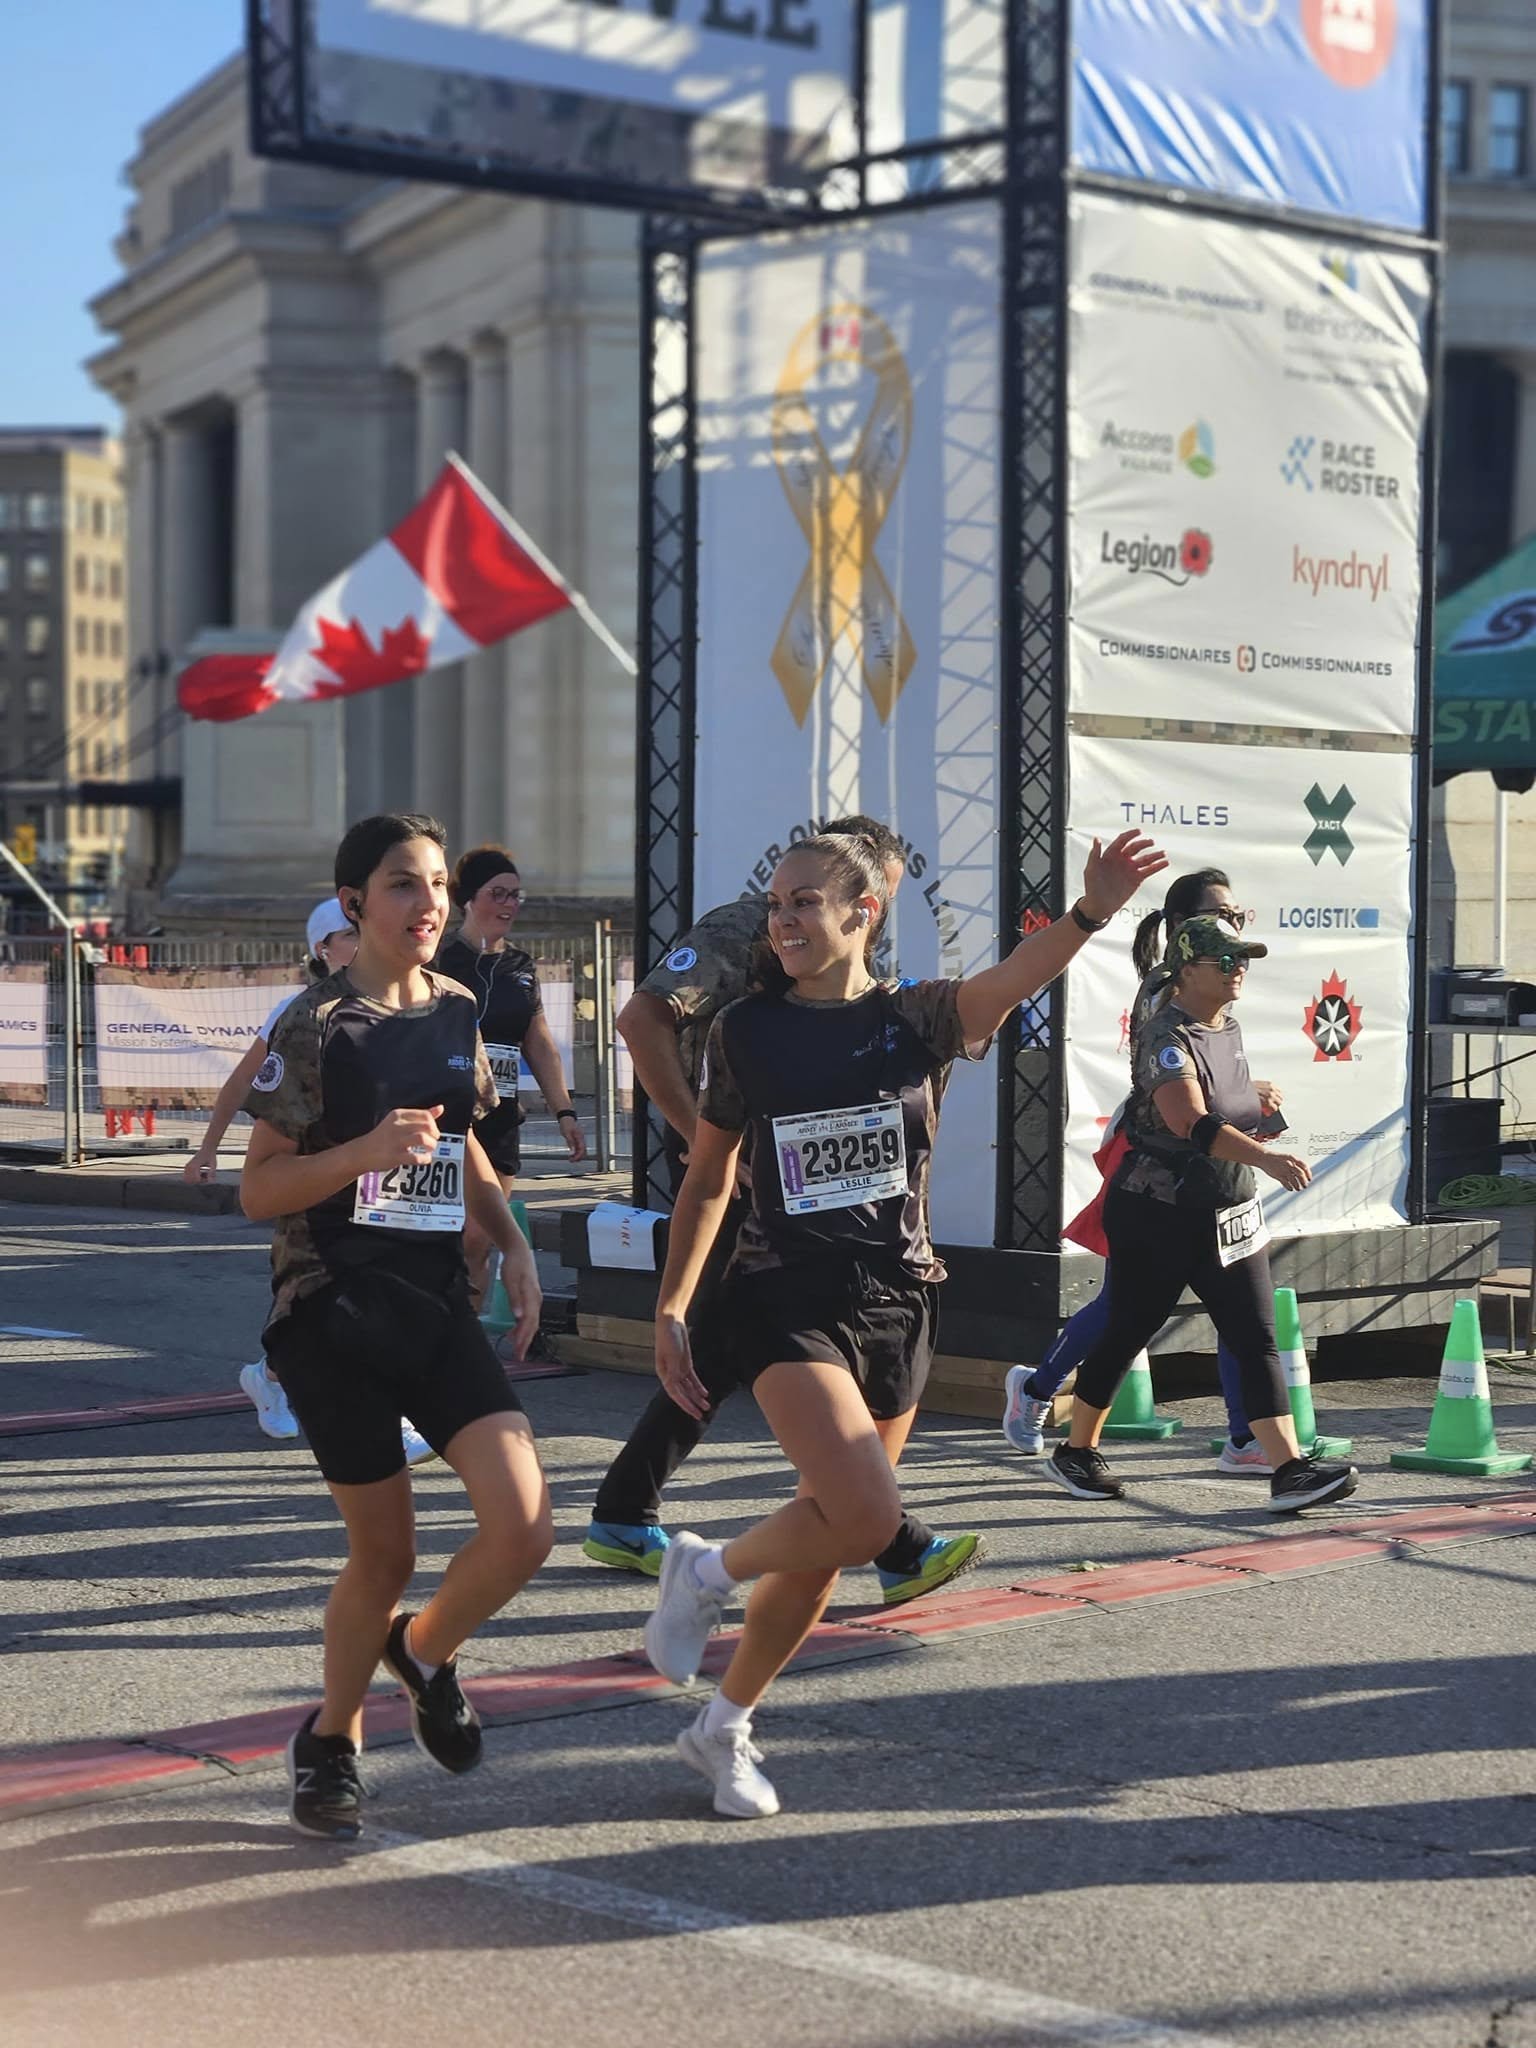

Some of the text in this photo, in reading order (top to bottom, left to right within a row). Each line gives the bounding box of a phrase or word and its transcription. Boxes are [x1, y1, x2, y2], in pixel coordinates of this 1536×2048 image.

[1321, 441, 1376, 469] RACE
[1320, 470, 1400, 499] ROSTER
[1100, 531, 1177, 573] Legion
[1292, 544, 1389, 602] kyndryl
[1433, 701, 1536, 743] STA
[1120, 802, 1229, 826] THALES
[1317, 820, 1341, 830] XACT
[107, 1023, 193, 1034] GENERAL
[490, 1059, 518, 1080] 449
[802, 1128, 899, 1179] 23259
[381, 1160, 458, 1199] 23260
[840, 1177, 872, 1189] LESLIE
[409, 1203, 433, 1213] OLIVIA
